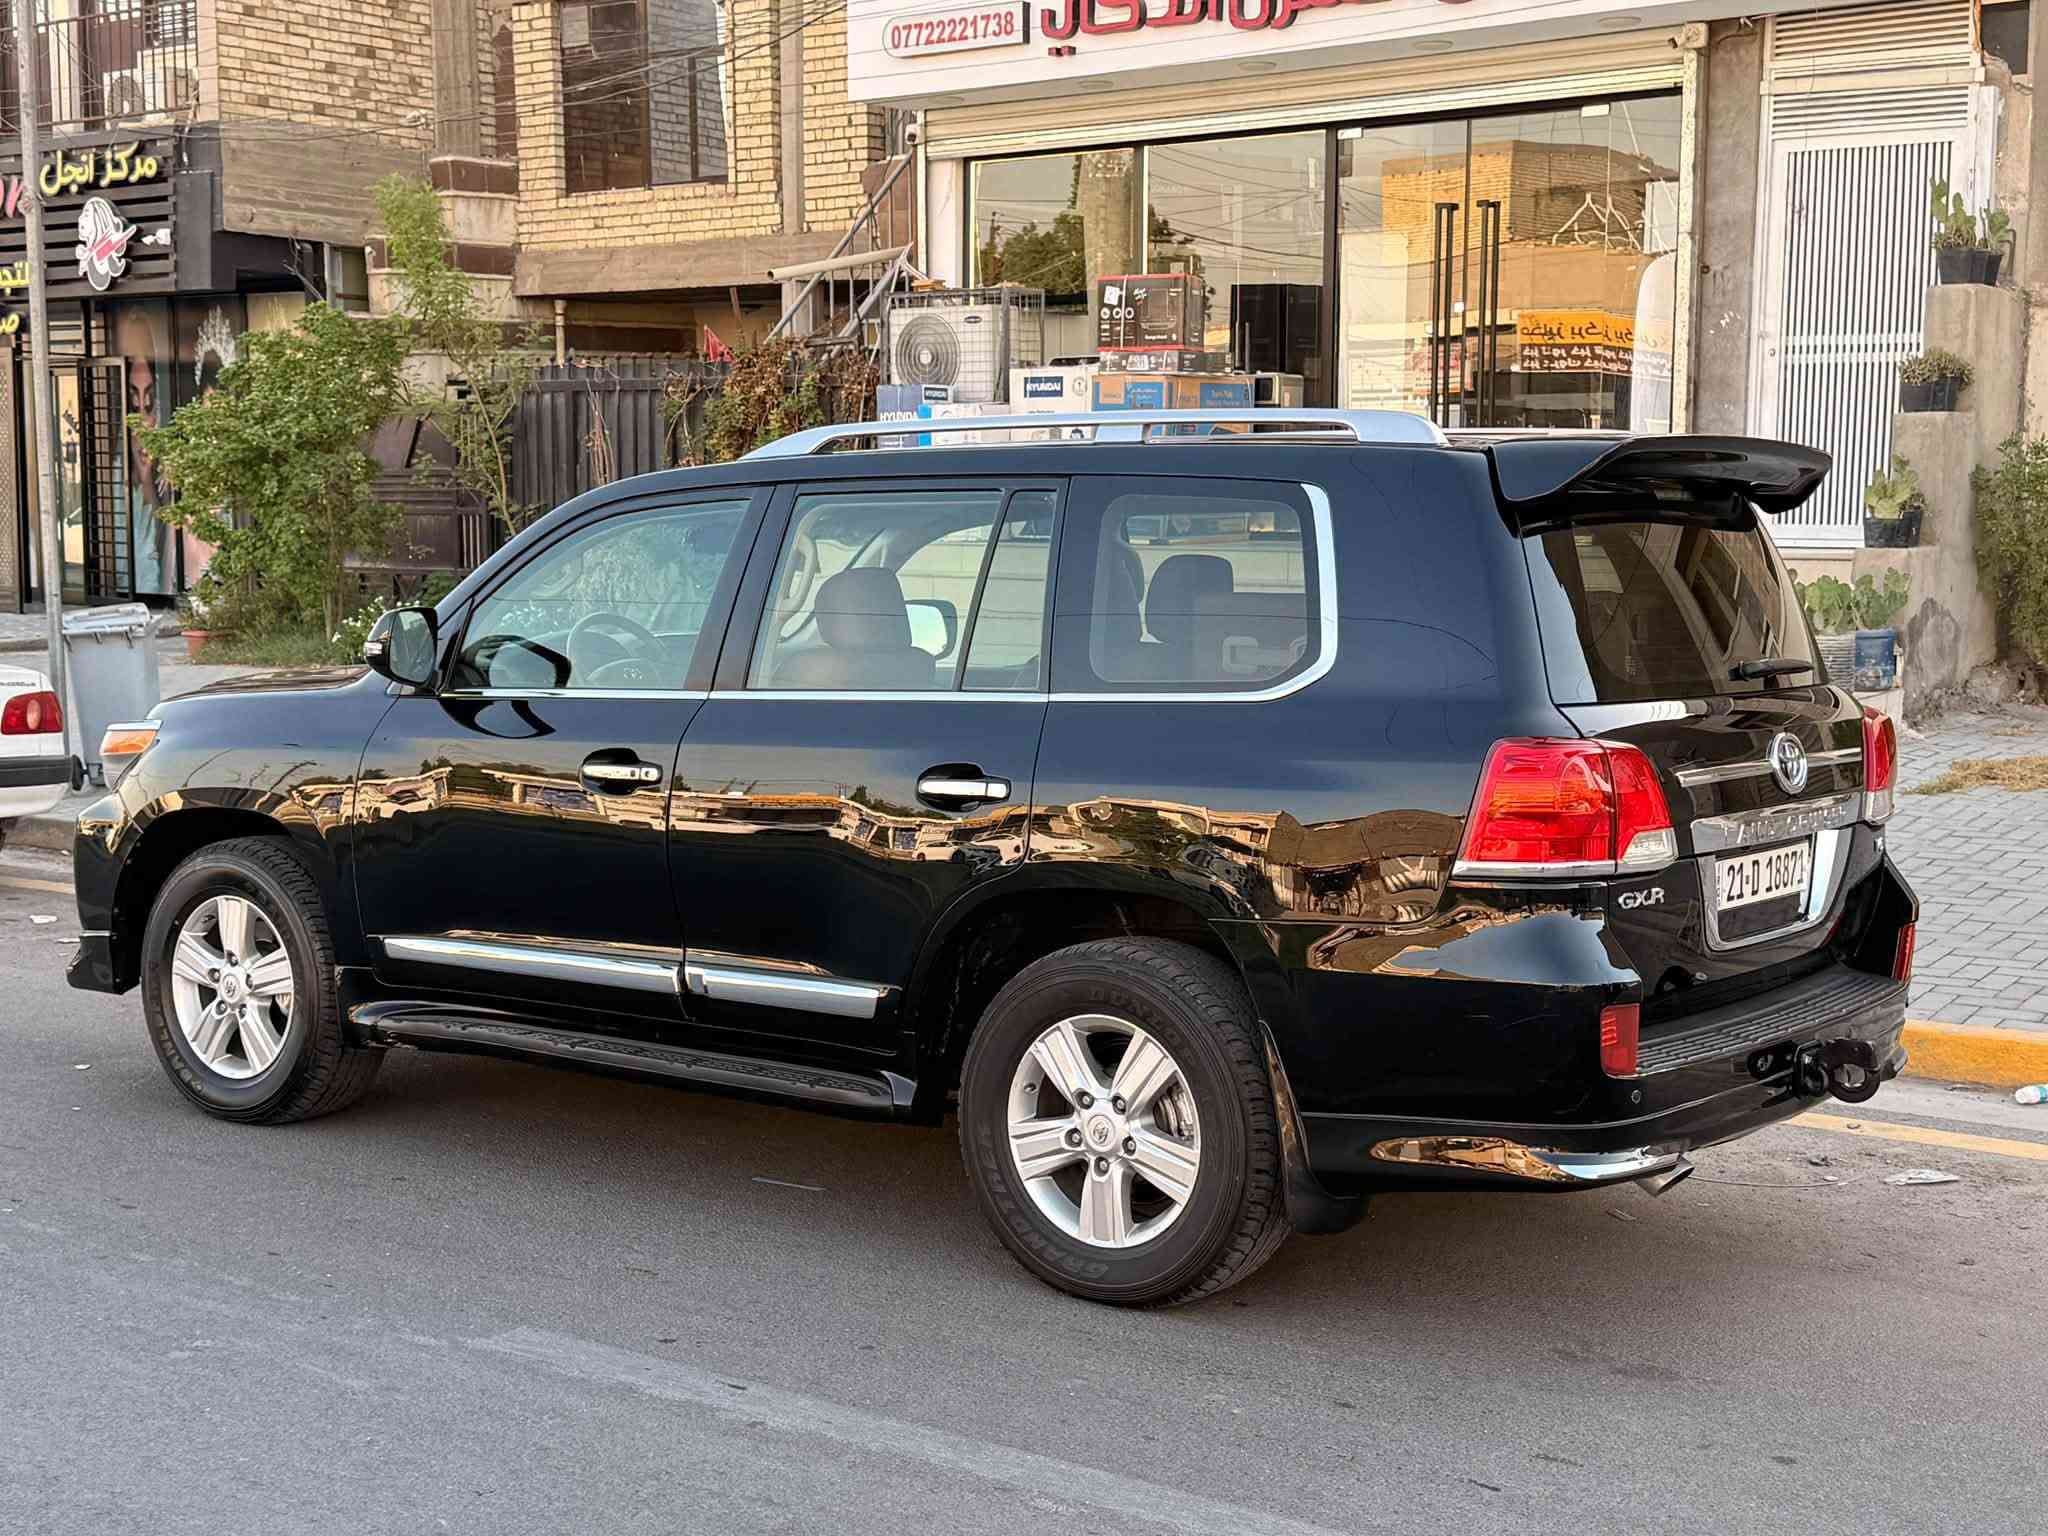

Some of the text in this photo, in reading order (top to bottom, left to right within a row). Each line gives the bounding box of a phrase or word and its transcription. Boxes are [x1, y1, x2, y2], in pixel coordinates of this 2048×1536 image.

[890, 10, 1015, 49] 07722221738
[99, 141, 158, 188] مركز
[1765, 849, 1805, 893] 18871
[1617, 887, 1665, 910] GXR
